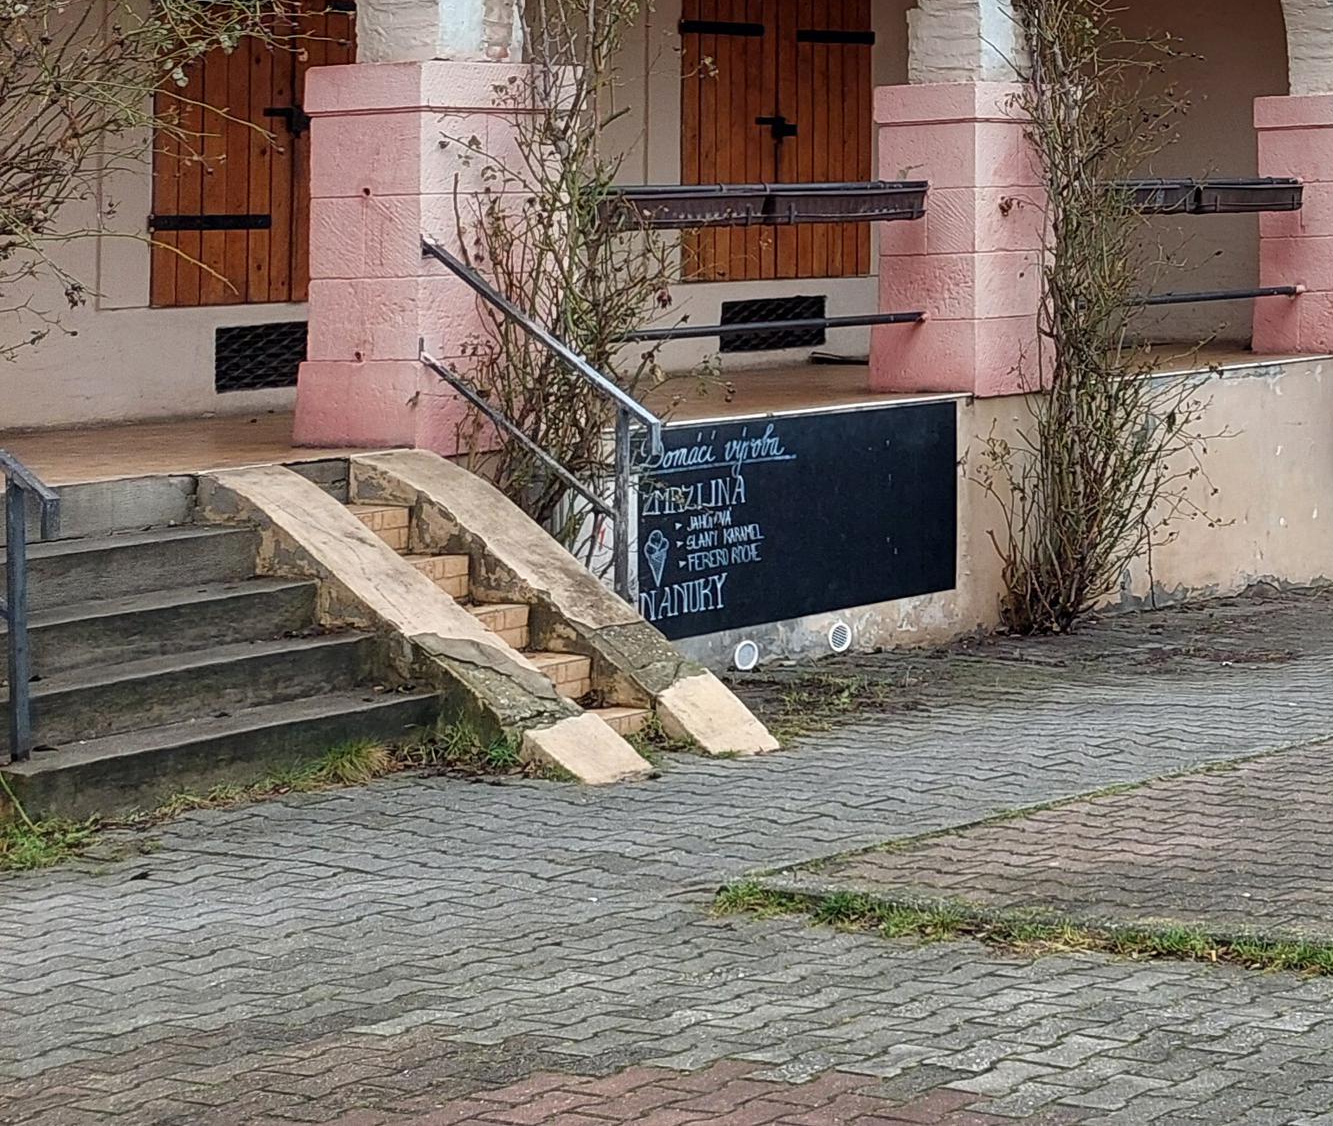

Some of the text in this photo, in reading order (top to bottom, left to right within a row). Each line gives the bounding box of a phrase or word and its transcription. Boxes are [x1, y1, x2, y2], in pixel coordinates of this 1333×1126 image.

[723, 424, 786, 477] výroba
[642, 475, 746, 516] ZMRZLINA
[722, 523, 766, 544] KARAMEL
[639, 573, 729, 622] NANUKY
